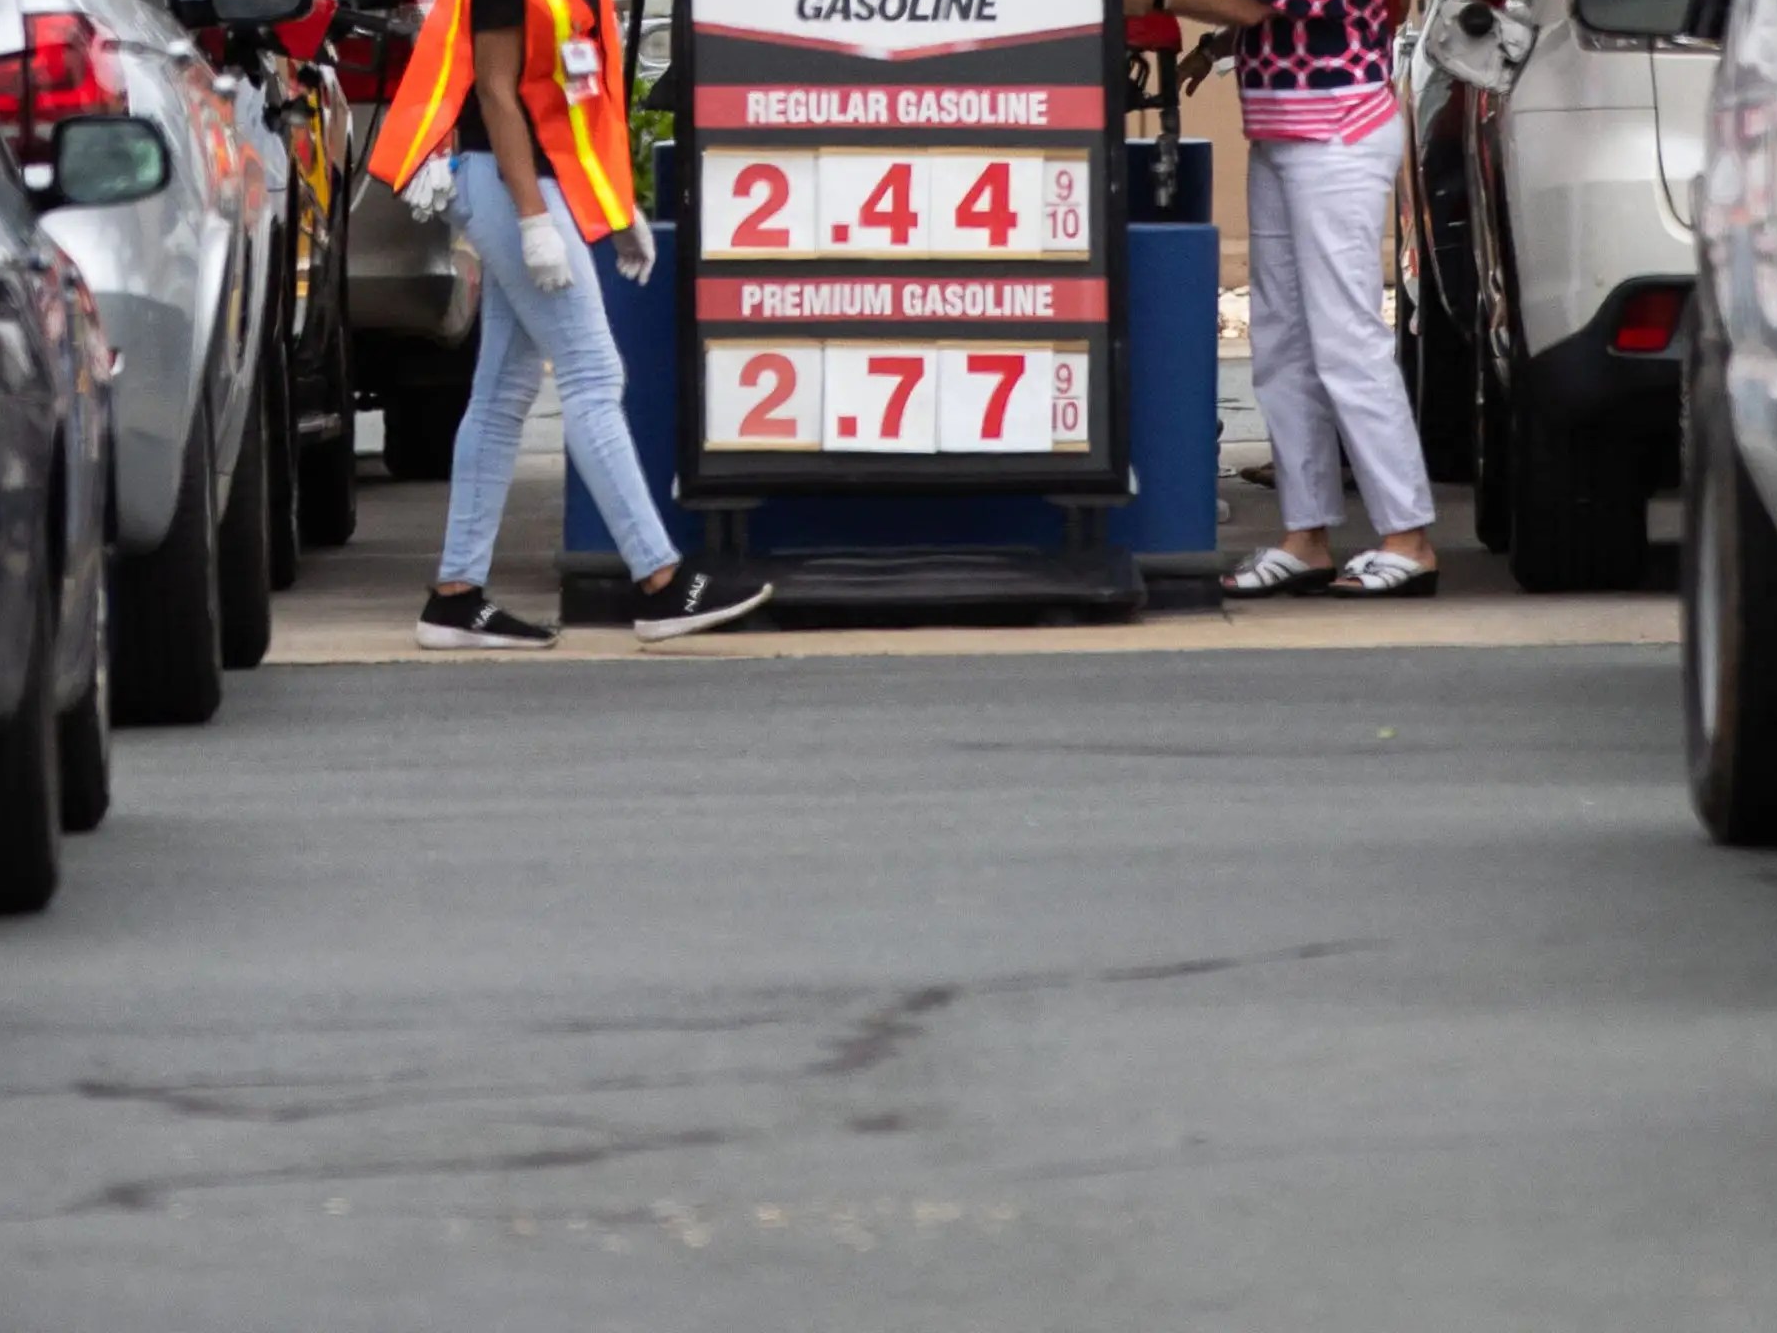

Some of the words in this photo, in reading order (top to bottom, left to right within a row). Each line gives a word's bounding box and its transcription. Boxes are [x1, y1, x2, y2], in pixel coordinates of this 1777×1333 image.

[746, 92, 889, 124] REGULAR
[896, 91, 1049, 125] GASOLINE
[741, 284, 892, 316] PREMIUM
[902, 284, 1054, 317] GASOLINE
